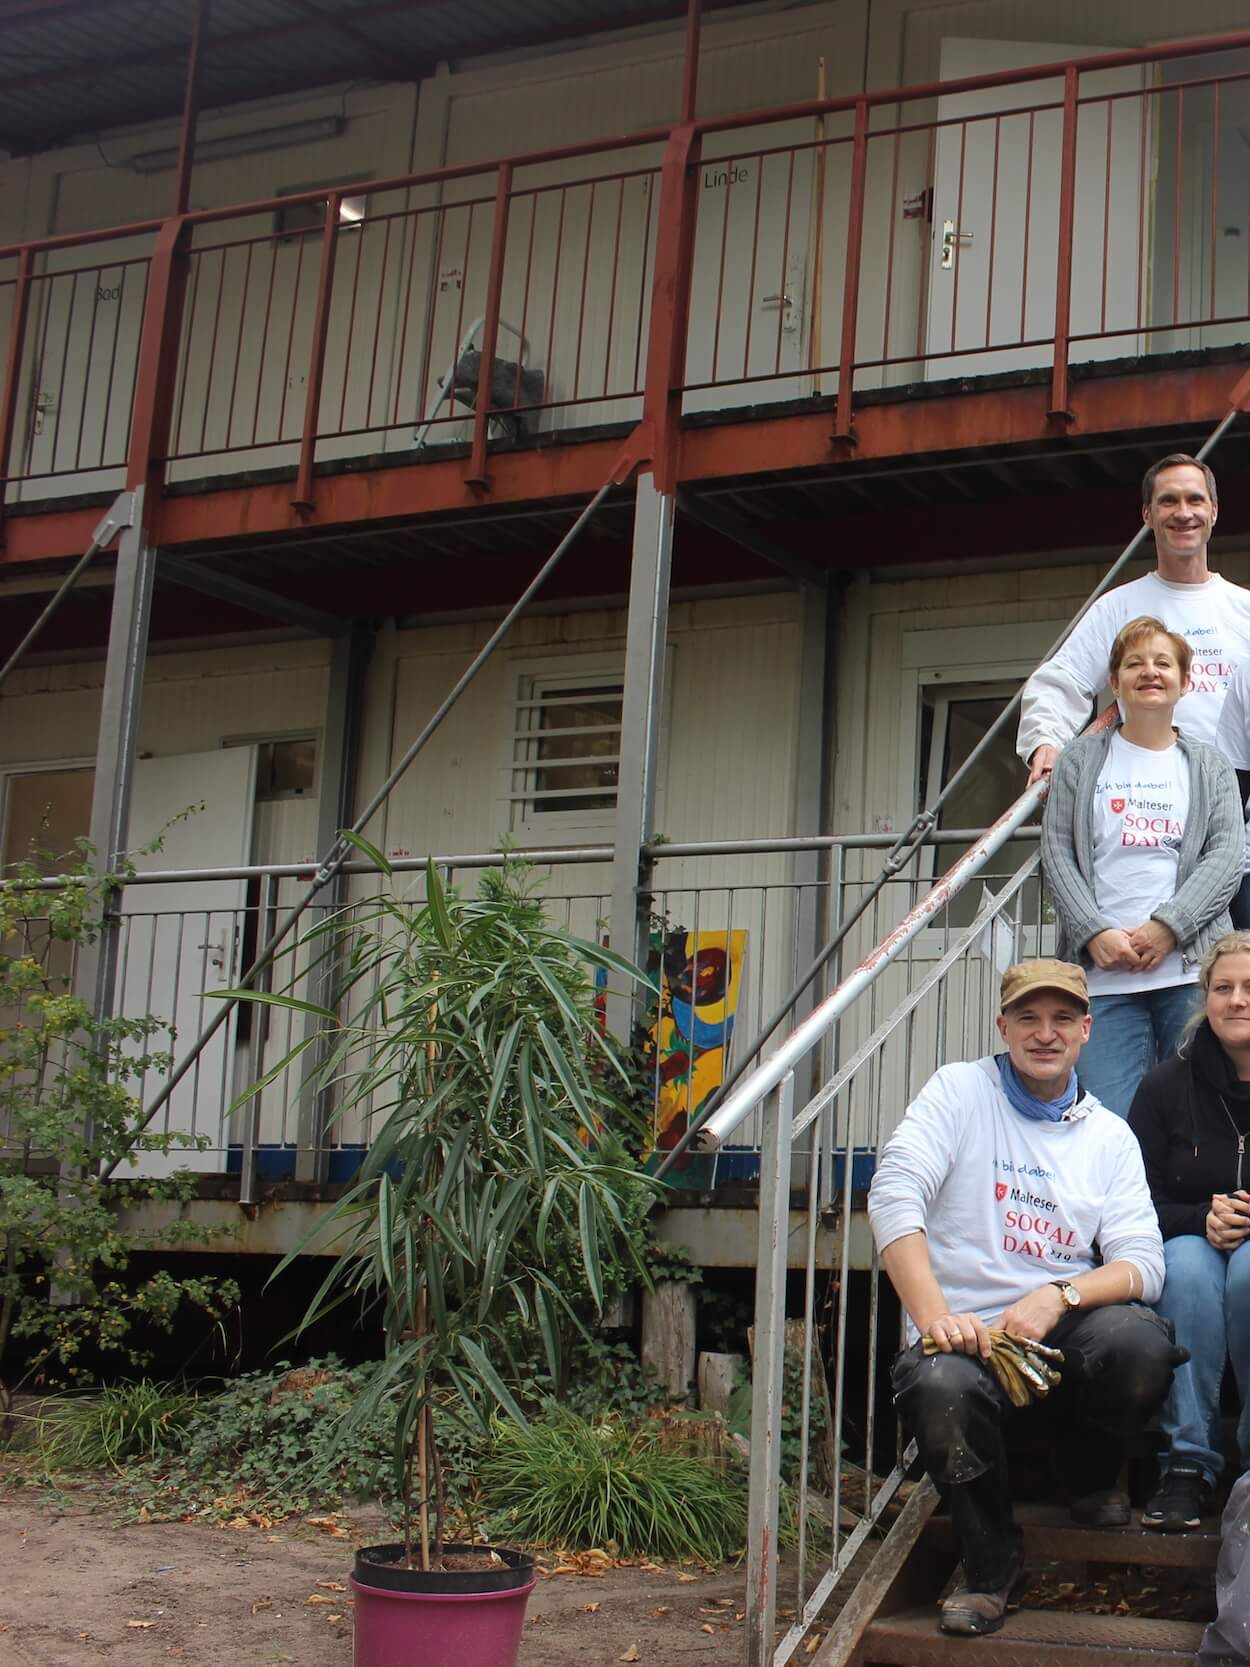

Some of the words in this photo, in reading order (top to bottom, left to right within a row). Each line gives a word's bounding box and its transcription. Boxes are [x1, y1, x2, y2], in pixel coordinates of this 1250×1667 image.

[705, 167, 748, 188] Linde
[1190, 648, 1223, 656] alteser
[1127, 798, 1174, 812] Malteser
[1124, 813, 1184, 836] SOCIA
[1122, 832, 1160, 847] DAY
[1010, 1187, 1059, 1213] Malteser
[1003, 1234, 1047, 1259] DAY
